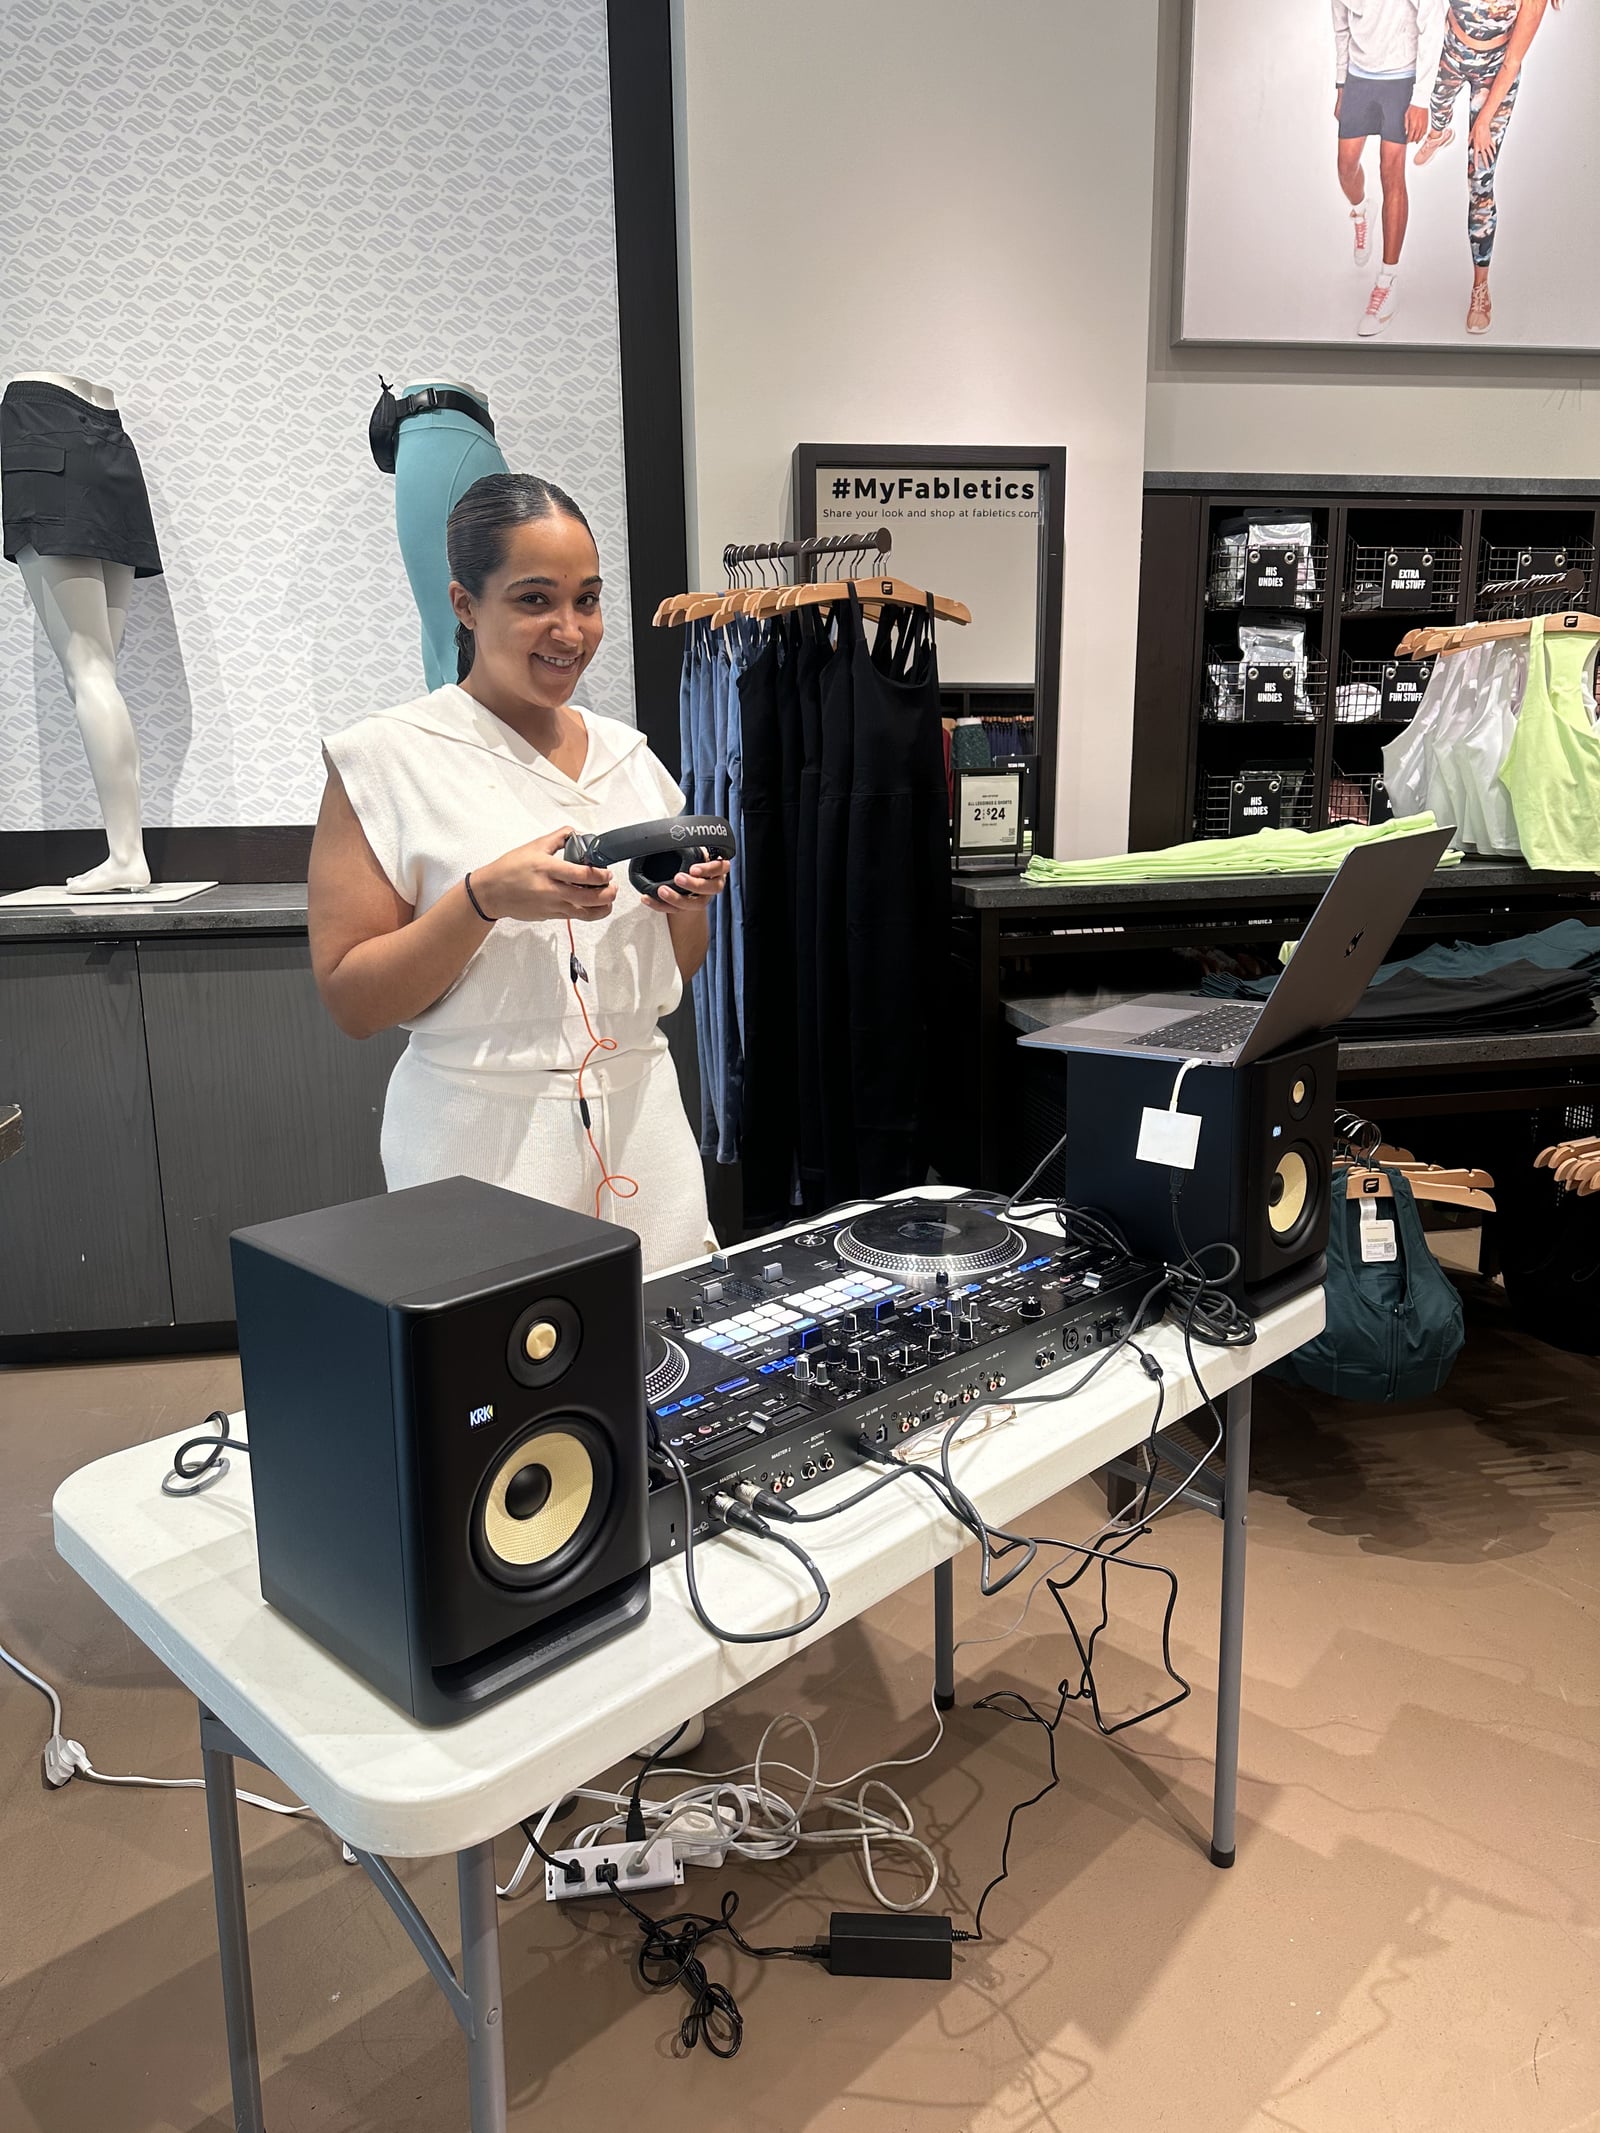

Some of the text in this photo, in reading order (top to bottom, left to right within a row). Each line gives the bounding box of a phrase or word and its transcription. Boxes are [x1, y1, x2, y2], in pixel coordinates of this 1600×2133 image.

[832, 476, 1034, 504] #MyFabletics
[823, 508, 1040, 520] Share your look and shop at fableticscom
[1265, 566, 1277, 576] HIS
[1399, 569, 1420, 579] EXTRA
[1258, 576, 1283, 587] UNDIES
[1391, 579, 1426, 590] FUN STUFF
[1264, 682, 1276, 692] HIS
[1396, 682, 1417, 692] EXTRA
[1257, 692, 1282, 703] UNDIES
[1389, 692, 1423, 702] FUN STUFF
[1250, 796, 1263, 806] HIS
[974, 808, 981, 821] 2
[987, 807, 1006, 820] $24
[1243, 806, 1268, 816] UNDIES
[470, 1404, 491, 1427] KRK
